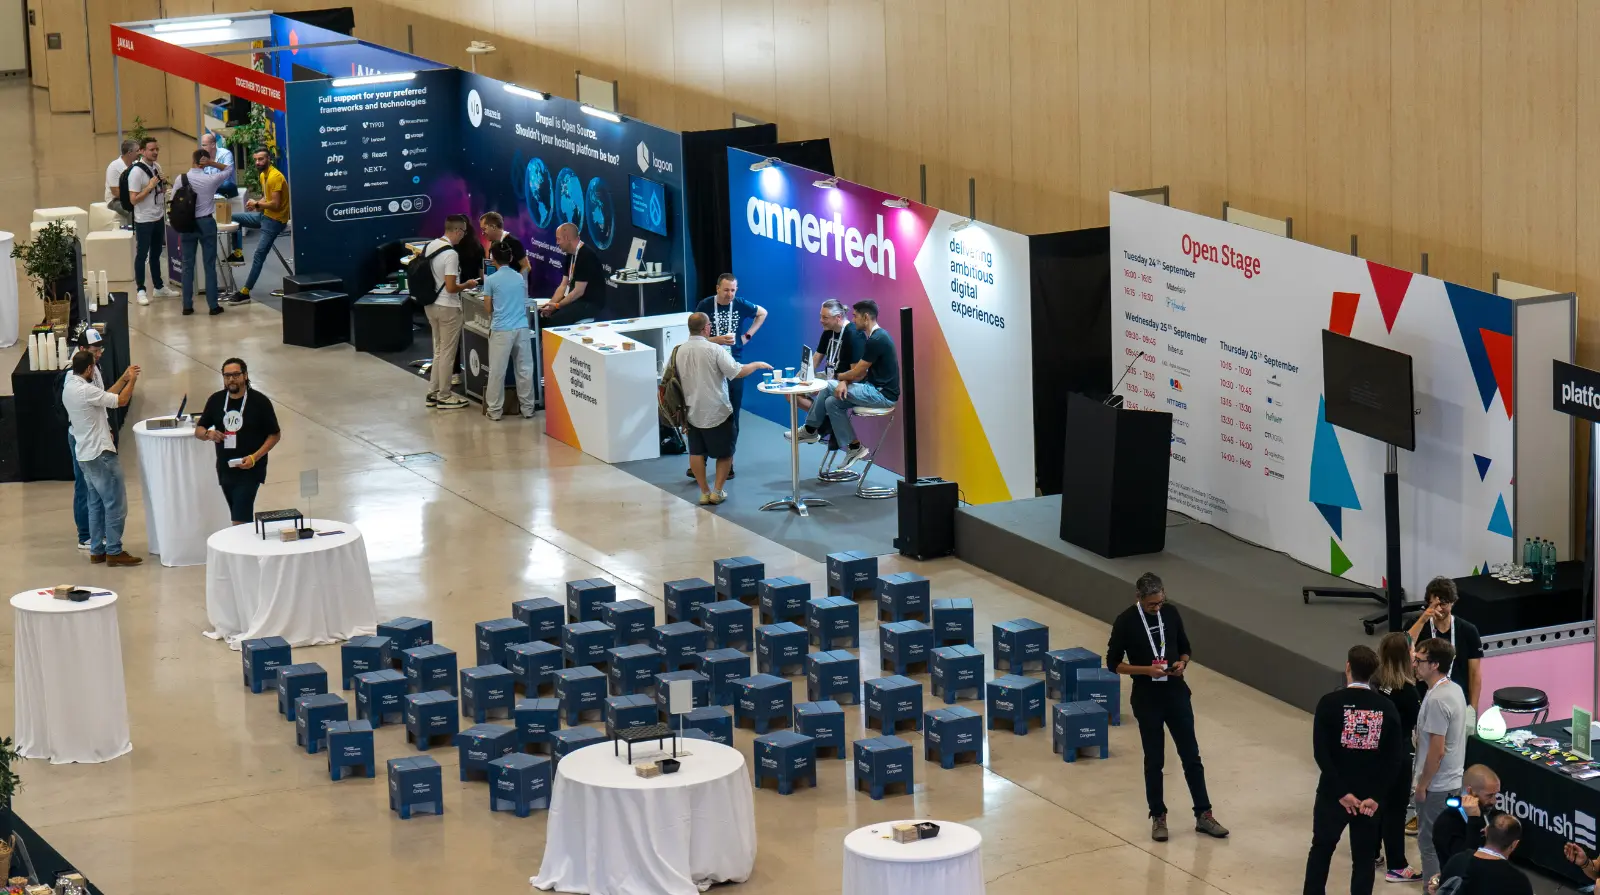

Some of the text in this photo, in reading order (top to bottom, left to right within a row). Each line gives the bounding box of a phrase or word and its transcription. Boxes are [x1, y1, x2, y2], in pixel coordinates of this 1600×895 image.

[234, 76, 256, 92] TOGETHER
[318, 87, 427, 104] Full support for your preferred
[320, 98, 426, 114] frameworks and technologies
[535, 112, 598, 140] Drupal is Open Source.
[515, 124, 619, 166] Shouldn't your hosting platform be too?
[327, 154, 344, 164] php
[652, 153, 673, 173] lagoon
[333, 204, 382, 216] Certifications
[746, 195, 896, 280] annertech
[949, 238, 992, 268] delivering
[1181, 234, 1261, 279] Open Stage
[950, 259, 994, 285] ambitious
[1124, 250, 1148, 267] Tuesday
[1162, 262, 1196, 279] September
[950, 278, 978, 300] digital
[951, 301, 1005, 329] experiences
[1125, 311, 1159, 331] Wednesday
[1173, 326, 1207, 344] September
[570, 355, 591, 373] delivering
[1220, 341, 1248, 359] Thursday
[1264, 355, 1299, 373] September
[570, 367, 591, 382] ambitious
[570, 376, 584, 389] digital
[570, 388, 597, 405] experiences
